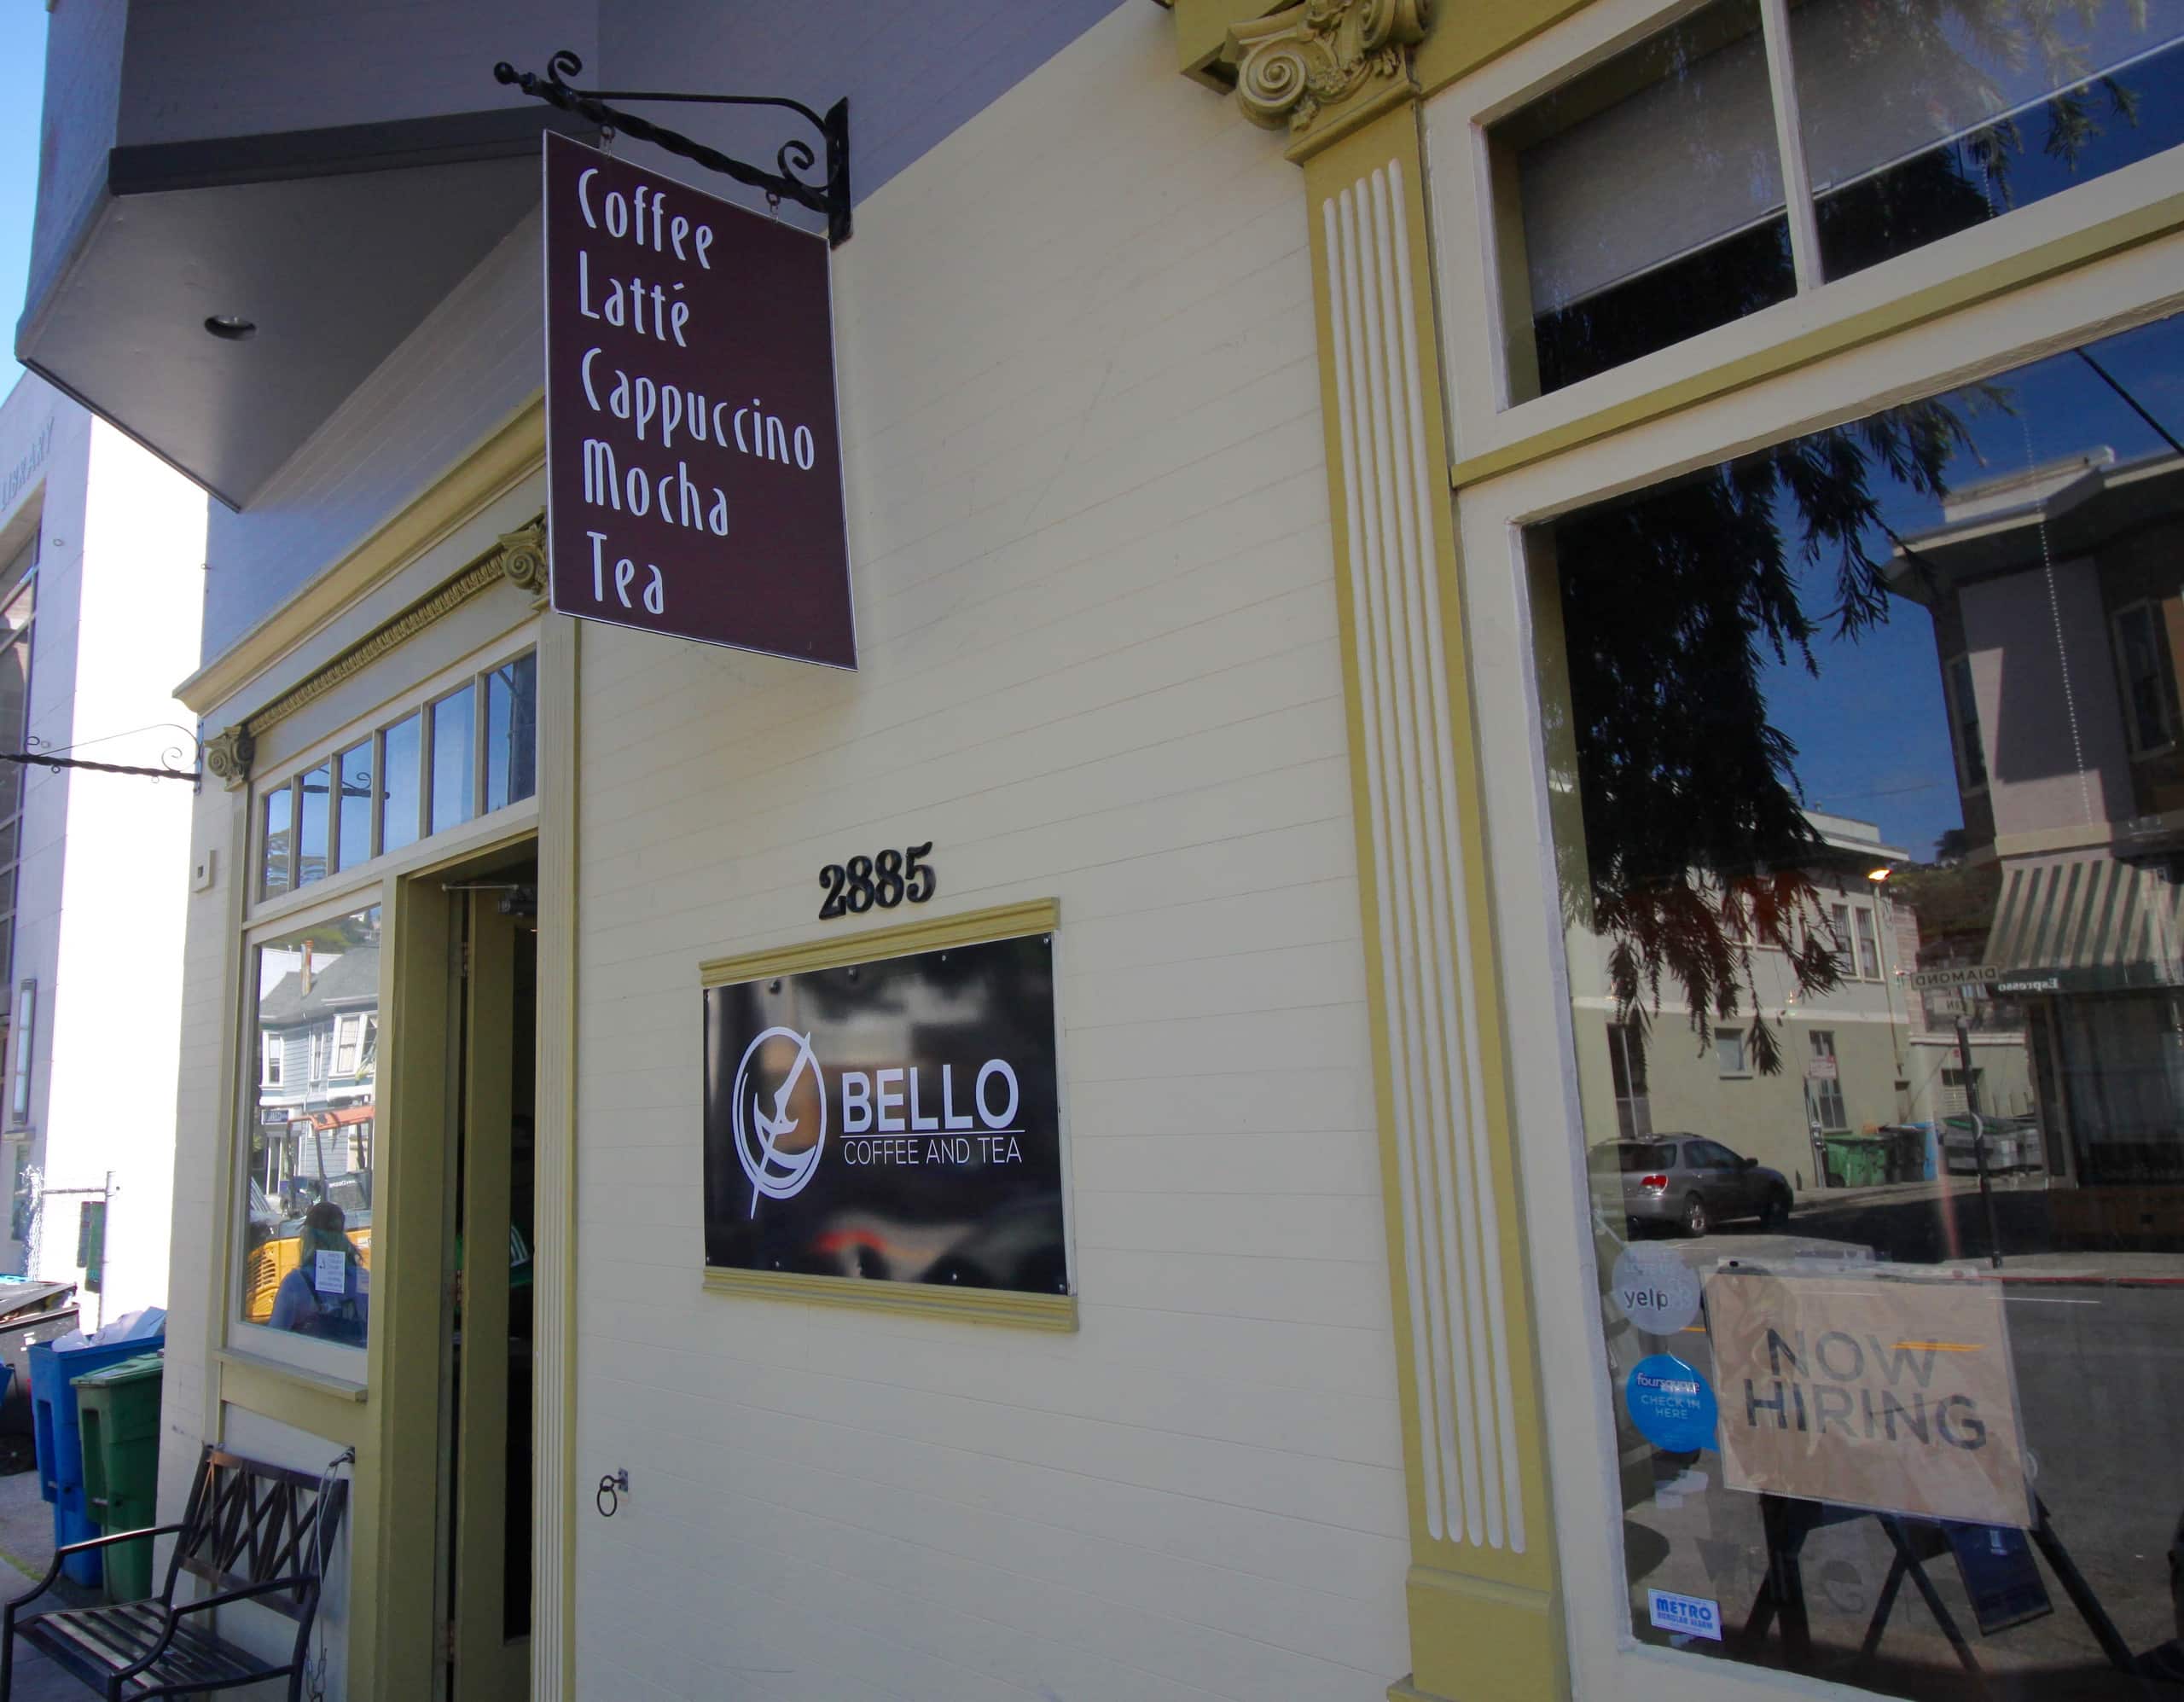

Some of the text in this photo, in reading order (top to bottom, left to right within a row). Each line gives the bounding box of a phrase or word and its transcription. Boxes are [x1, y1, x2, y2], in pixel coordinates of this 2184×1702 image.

[578, 168, 713, 269] Coffee
[580, 251, 688, 347] Latté
[582, 347, 815, 470] Cappuccino
[584, 439, 729, 536] Mocha
[587, 531, 664, 614] Tea
[819, 841, 937, 920] 2885
[842, 1059, 1019, 1130] BELLO
[844, 1136, 1022, 1165] COFFEE AND TEA
[1624, 1288, 1669, 1310] yelp
[1637, 1372, 1700, 1391] foursquare
[1766, 1327, 1939, 1388] NOW
[1641, 1394, 1683, 1408] CHECK
[1655, 1407, 1688, 1420] HERE
[1744, 1379, 1987, 1450] HIRING
[1656, 1598, 1711, 1620] METRO
